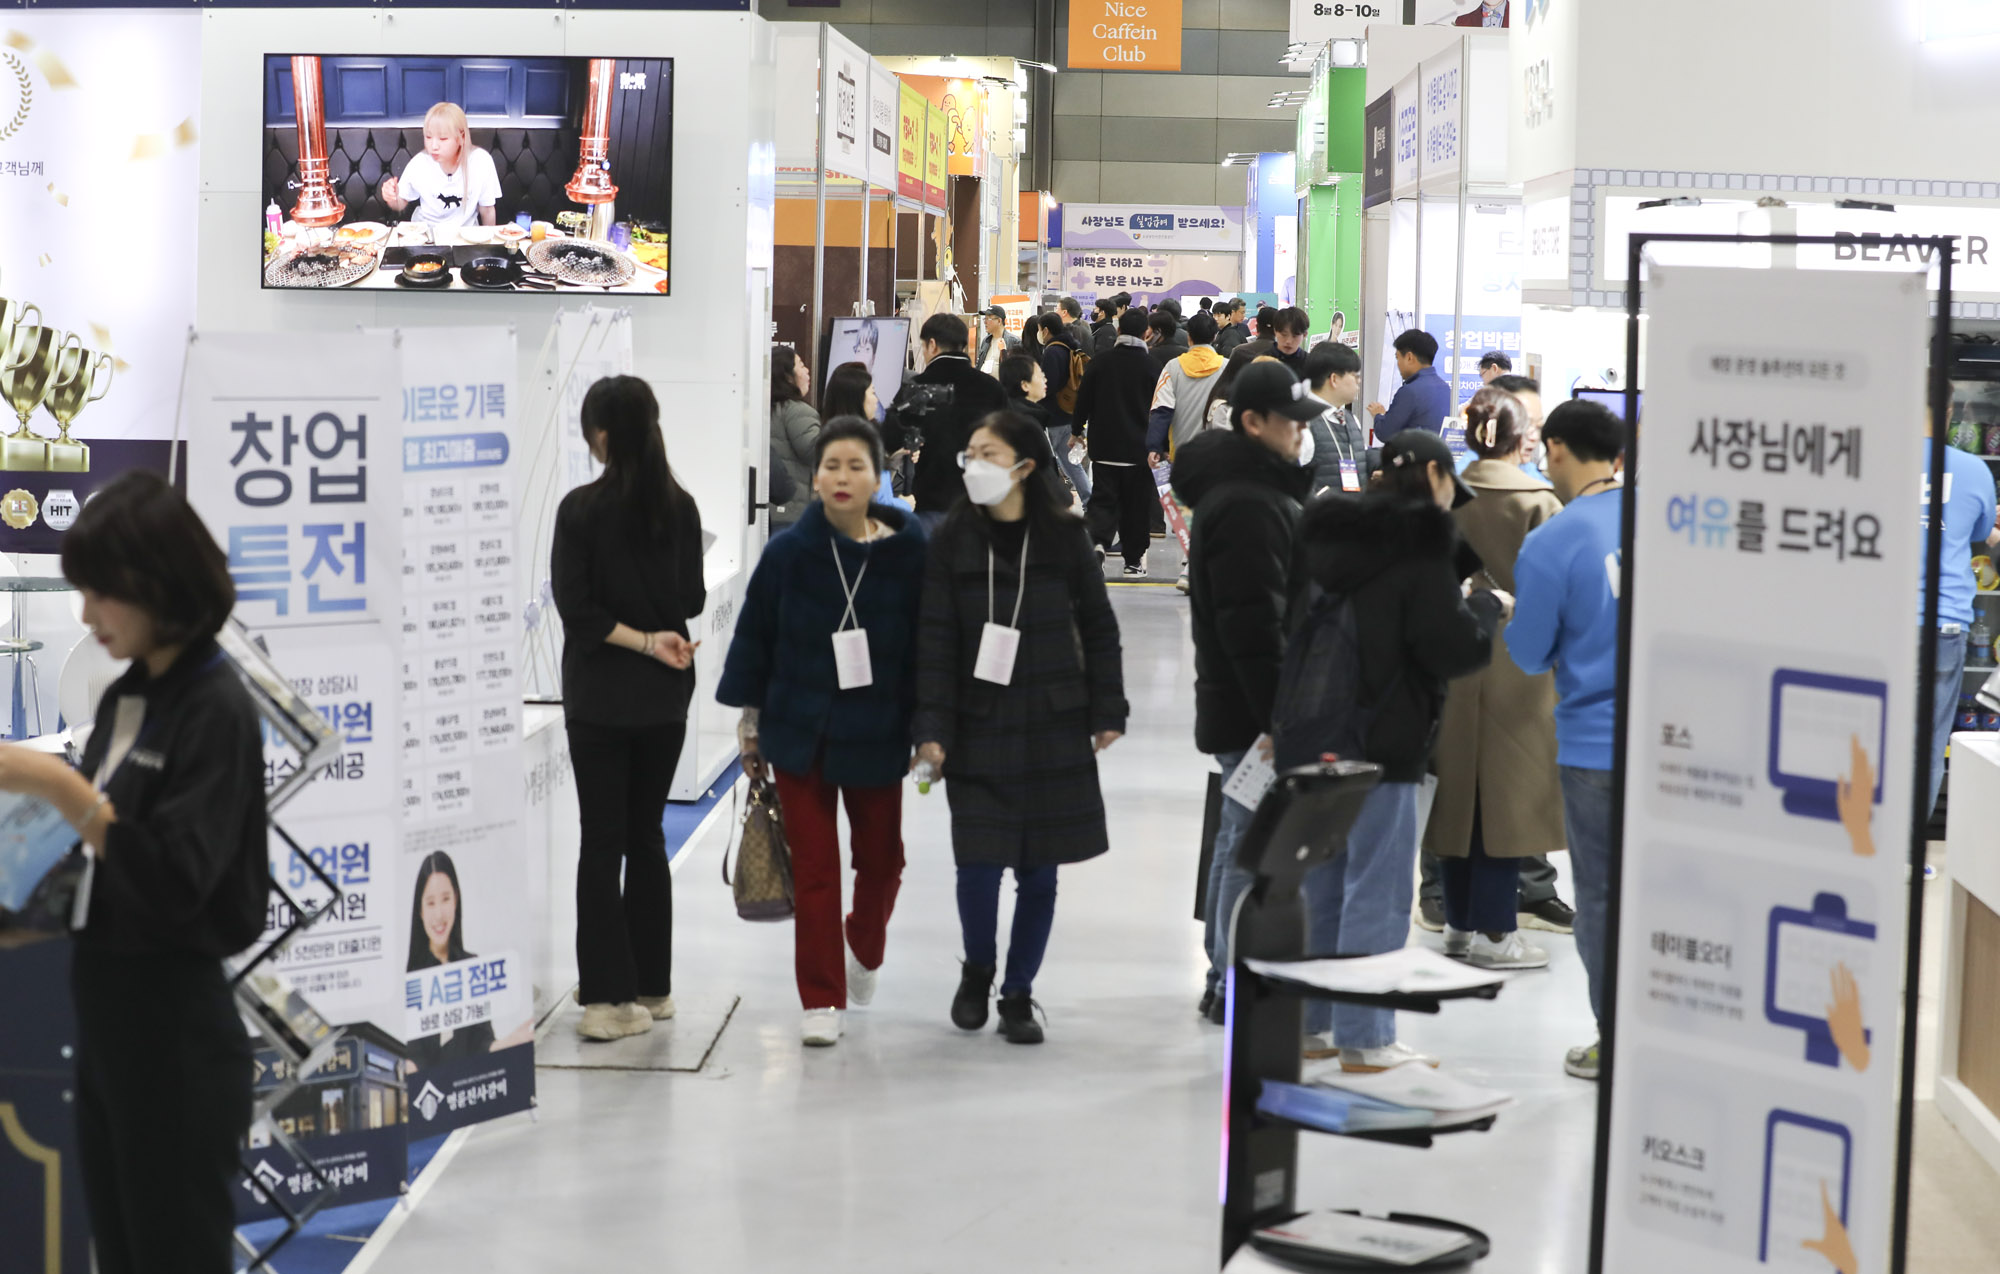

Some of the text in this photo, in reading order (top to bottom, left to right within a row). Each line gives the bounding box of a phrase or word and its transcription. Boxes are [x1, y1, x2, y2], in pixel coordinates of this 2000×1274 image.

[1104, 2, 1148, 18] Nice
[1092, 23, 1157, 41] Caffein
[1102, 44, 1146, 62] Club
[1081, 215, 1225, 229] 사장님도 실업급여 받으세요!
[1073, 256, 1143, 268] 혜택은 더하고
[1834, 231, 1989, 265] BEAVER
[1094, 275, 1163, 287] 부담은 나누고
[464, 383, 505, 419] 기록
[229, 412, 367, 507] 창업
[1690, 417, 1862, 480] 사장님에게
[50, 505, 72, 517] HIT
[1667, 495, 1883, 562] 여유를 드려요
[227, 521, 367, 616] 특전
[406, 978, 423, 1011] 특
[429, 969, 463, 1006] A급
[469, 959, 507, 998] 점포
[1642, 1135, 1707, 1172] 키오스크
